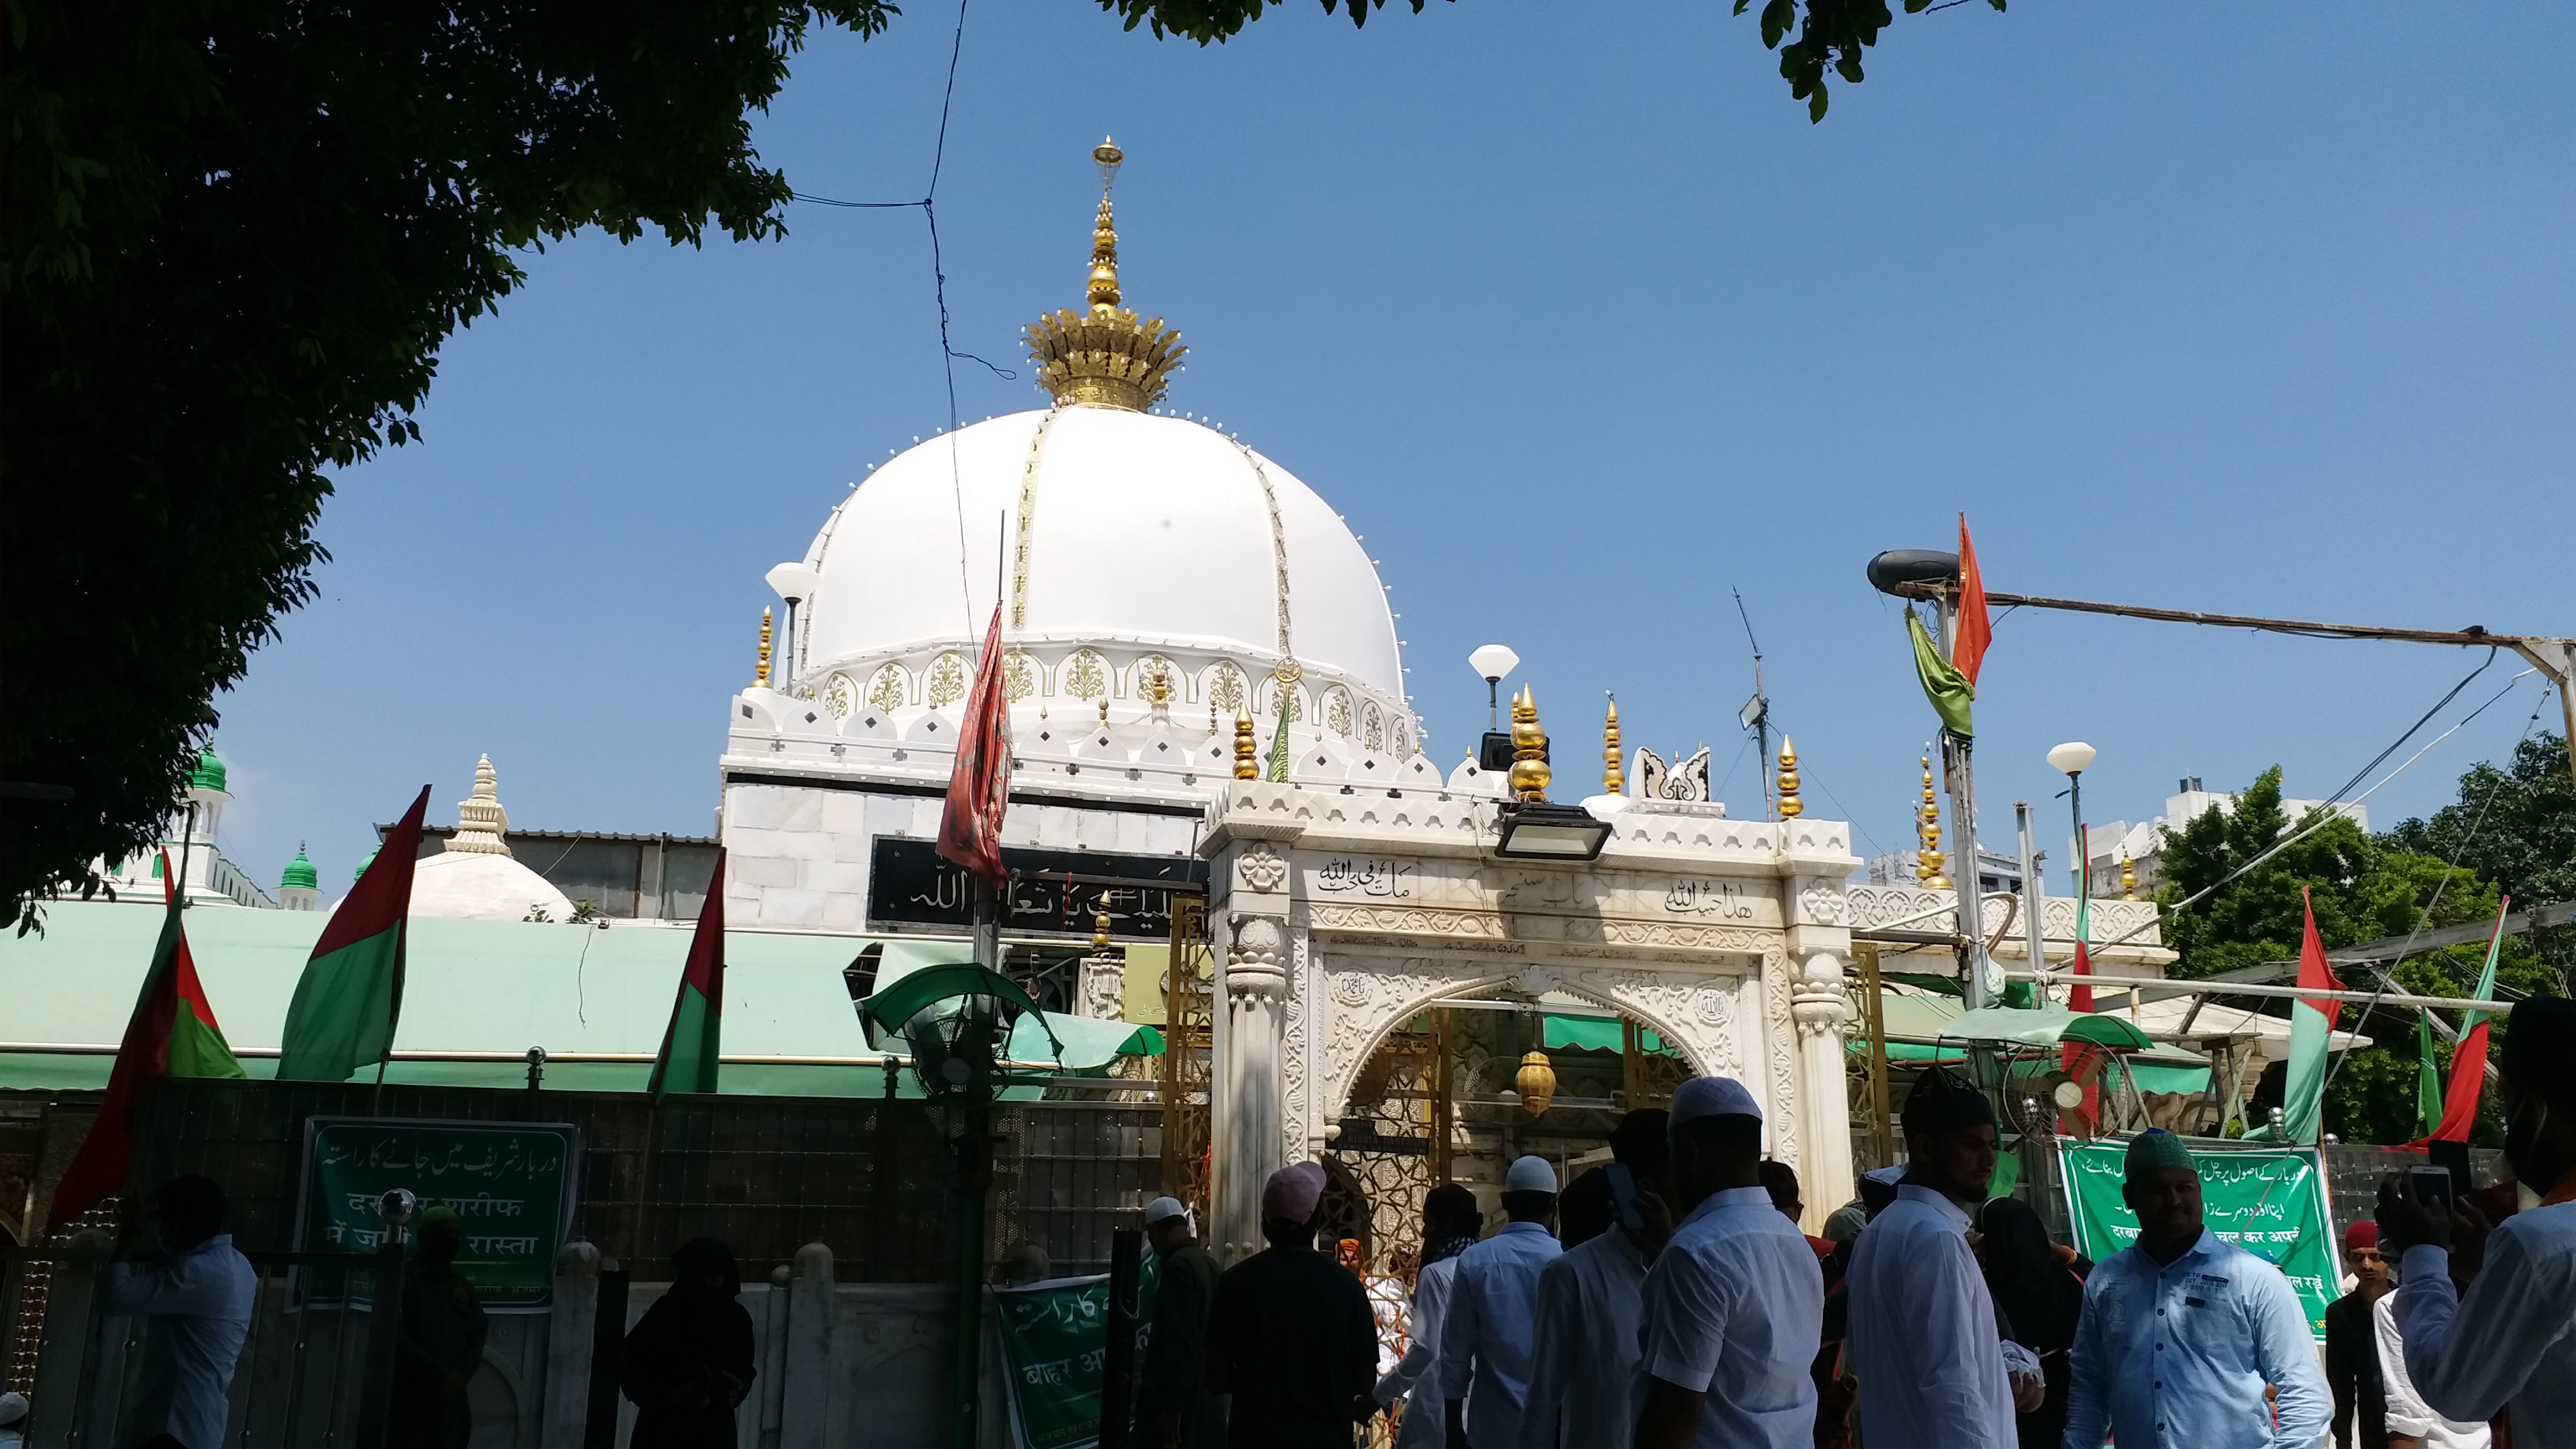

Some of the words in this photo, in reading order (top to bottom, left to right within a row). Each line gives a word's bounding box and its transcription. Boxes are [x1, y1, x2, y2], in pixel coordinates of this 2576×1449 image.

[1319, 858, 1352, 881] الله
[910, 863, 968, 913] الله
[1666, 880, 1697, 907] الله
[381, 1138, 430, 1179] جانے
[431, 1141, 463, 1175] میں
[463, 1137, 521, 1181] شریف
[466, 1236, 539, 1254] रास्ता
